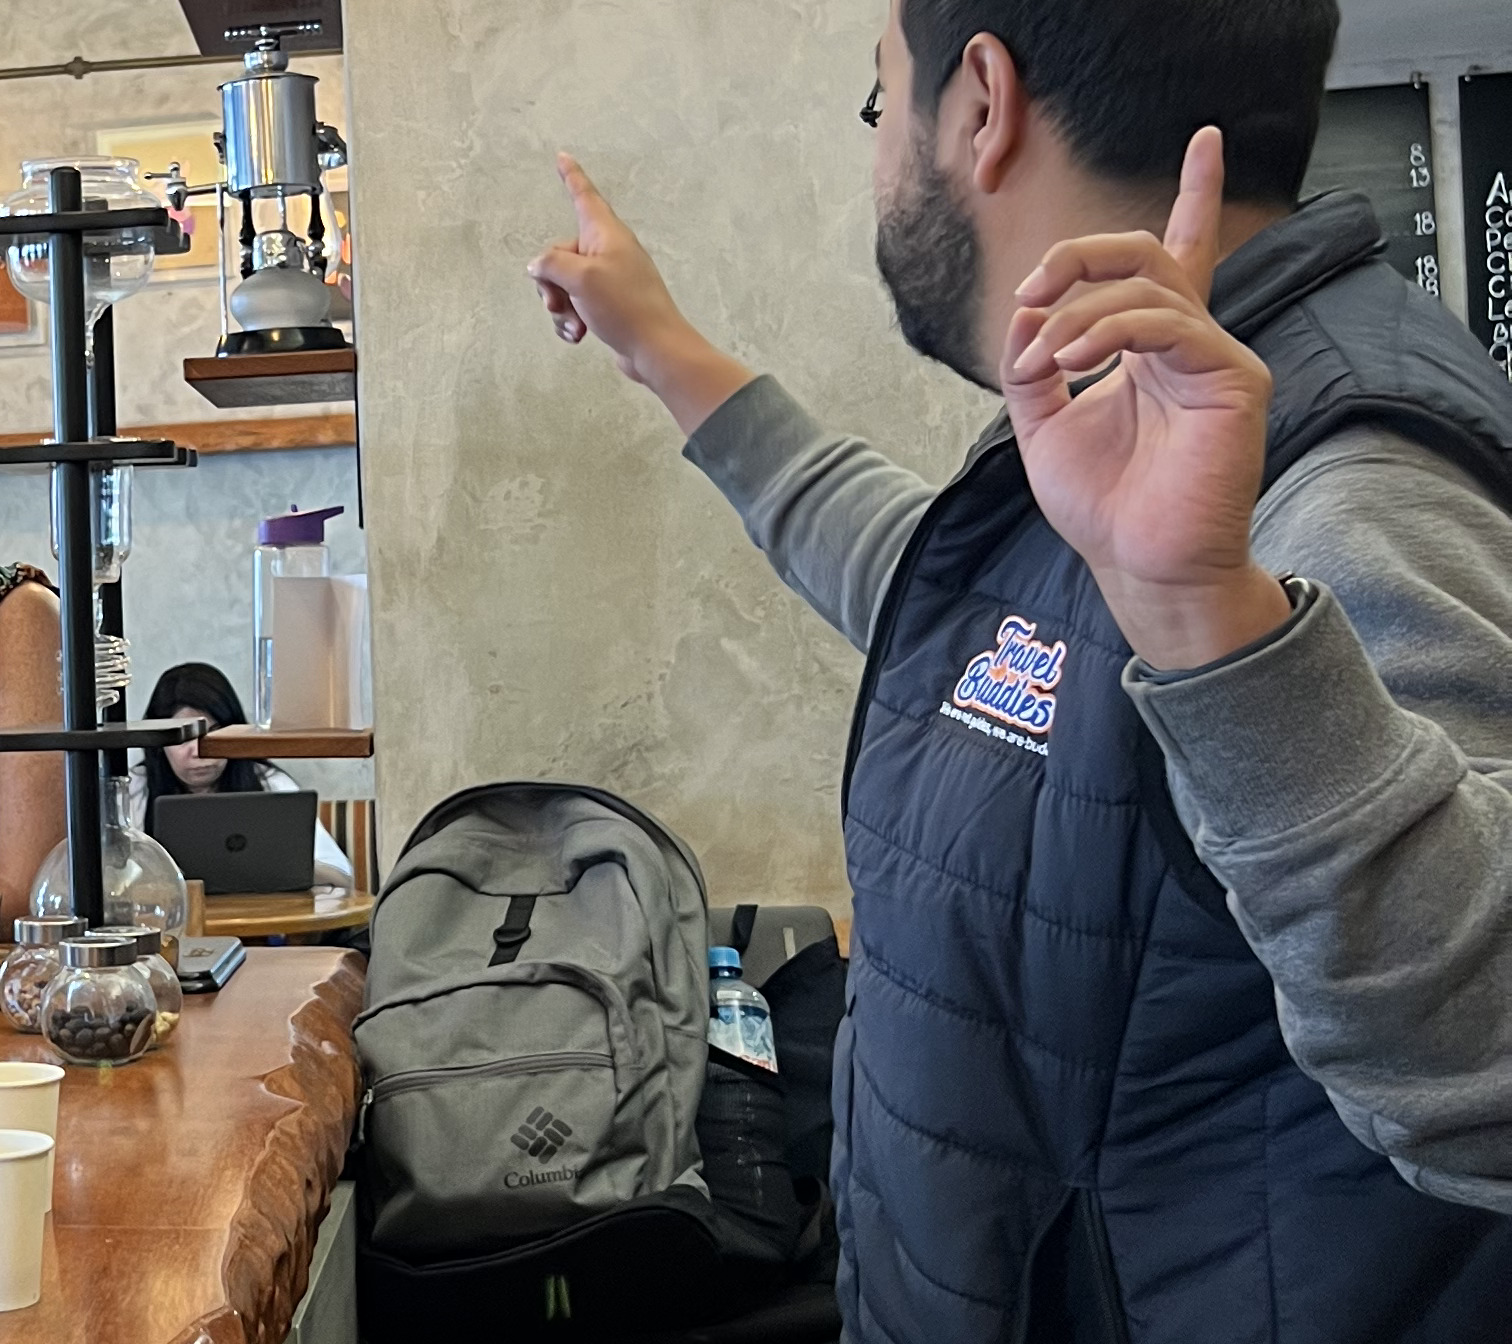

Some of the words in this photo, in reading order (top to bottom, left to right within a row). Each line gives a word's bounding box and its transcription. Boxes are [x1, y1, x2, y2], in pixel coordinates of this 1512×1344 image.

[1409, 167, 1431, 188] 13
[1414, 211, 1436, 236] 18
[1414, 255, 1438, 280] 18
[993, 617, 1064, 686] Travel
[956, 654, 1054, 729] Buddies
